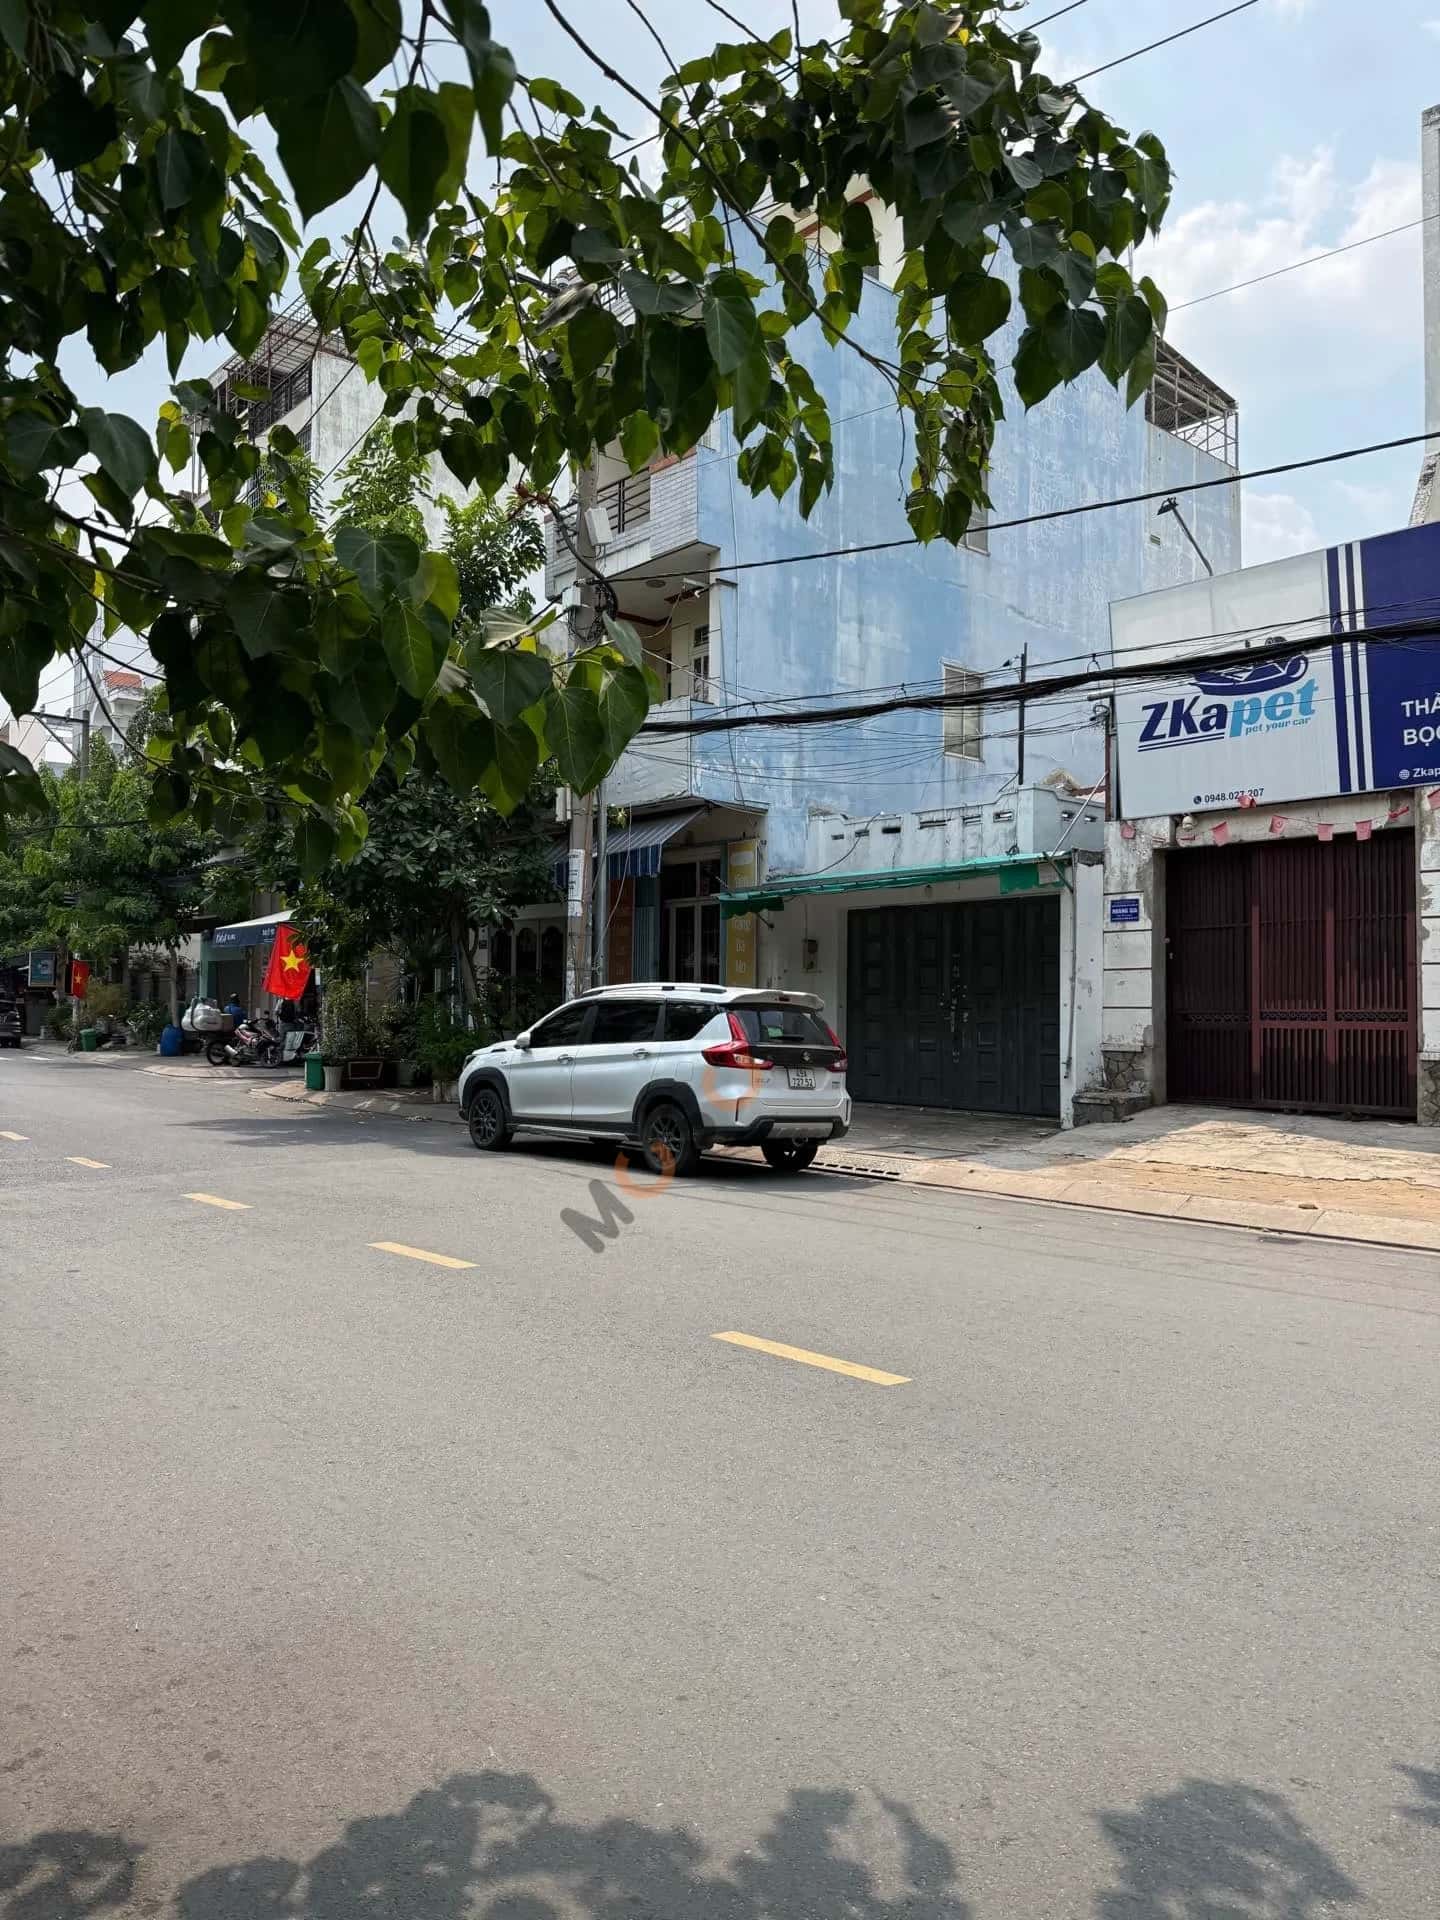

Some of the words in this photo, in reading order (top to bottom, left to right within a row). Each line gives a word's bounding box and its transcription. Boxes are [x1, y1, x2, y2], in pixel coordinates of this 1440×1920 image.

[1245, 721, 1263, 736] pet
[1264, 719, 1291, 734] your
[1292, 717, 1312, 727] car
[1204, 788, 1265, 803] 0948.027207
